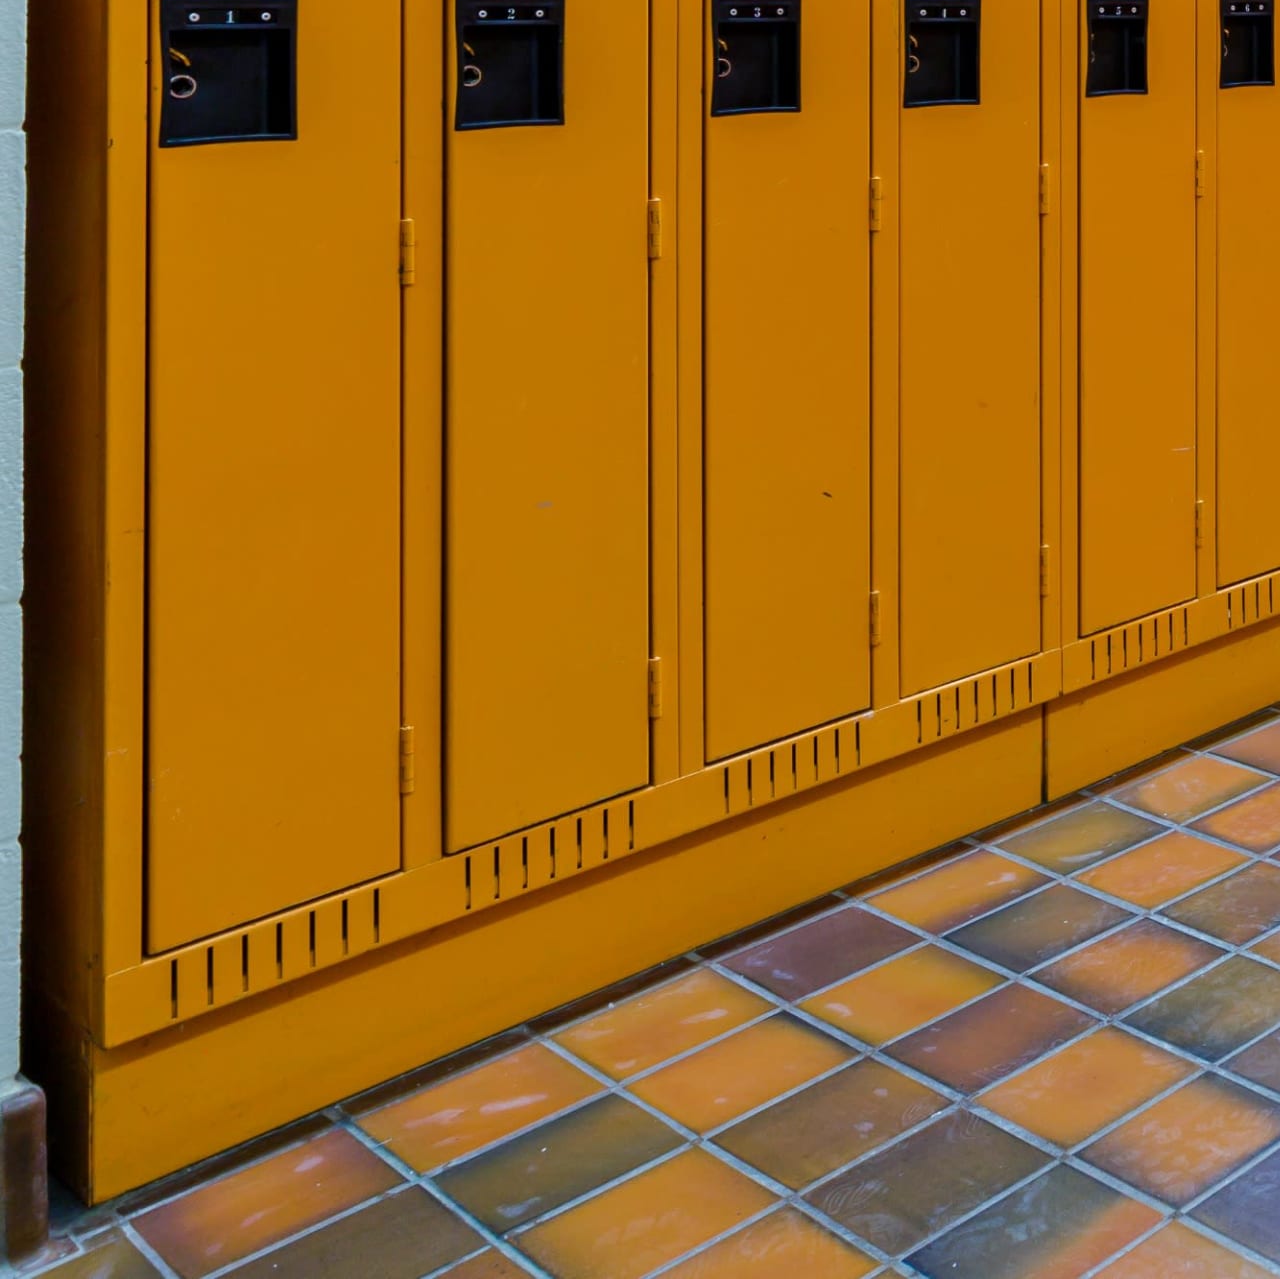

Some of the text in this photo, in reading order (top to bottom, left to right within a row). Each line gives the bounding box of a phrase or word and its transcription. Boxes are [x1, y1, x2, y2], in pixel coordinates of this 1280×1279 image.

[507, 8, 516, 20] 2
[754, 7, 761, 18] 3
[1116, 6, 1122, 15] 5
[226, 10, 235, 24] 1
